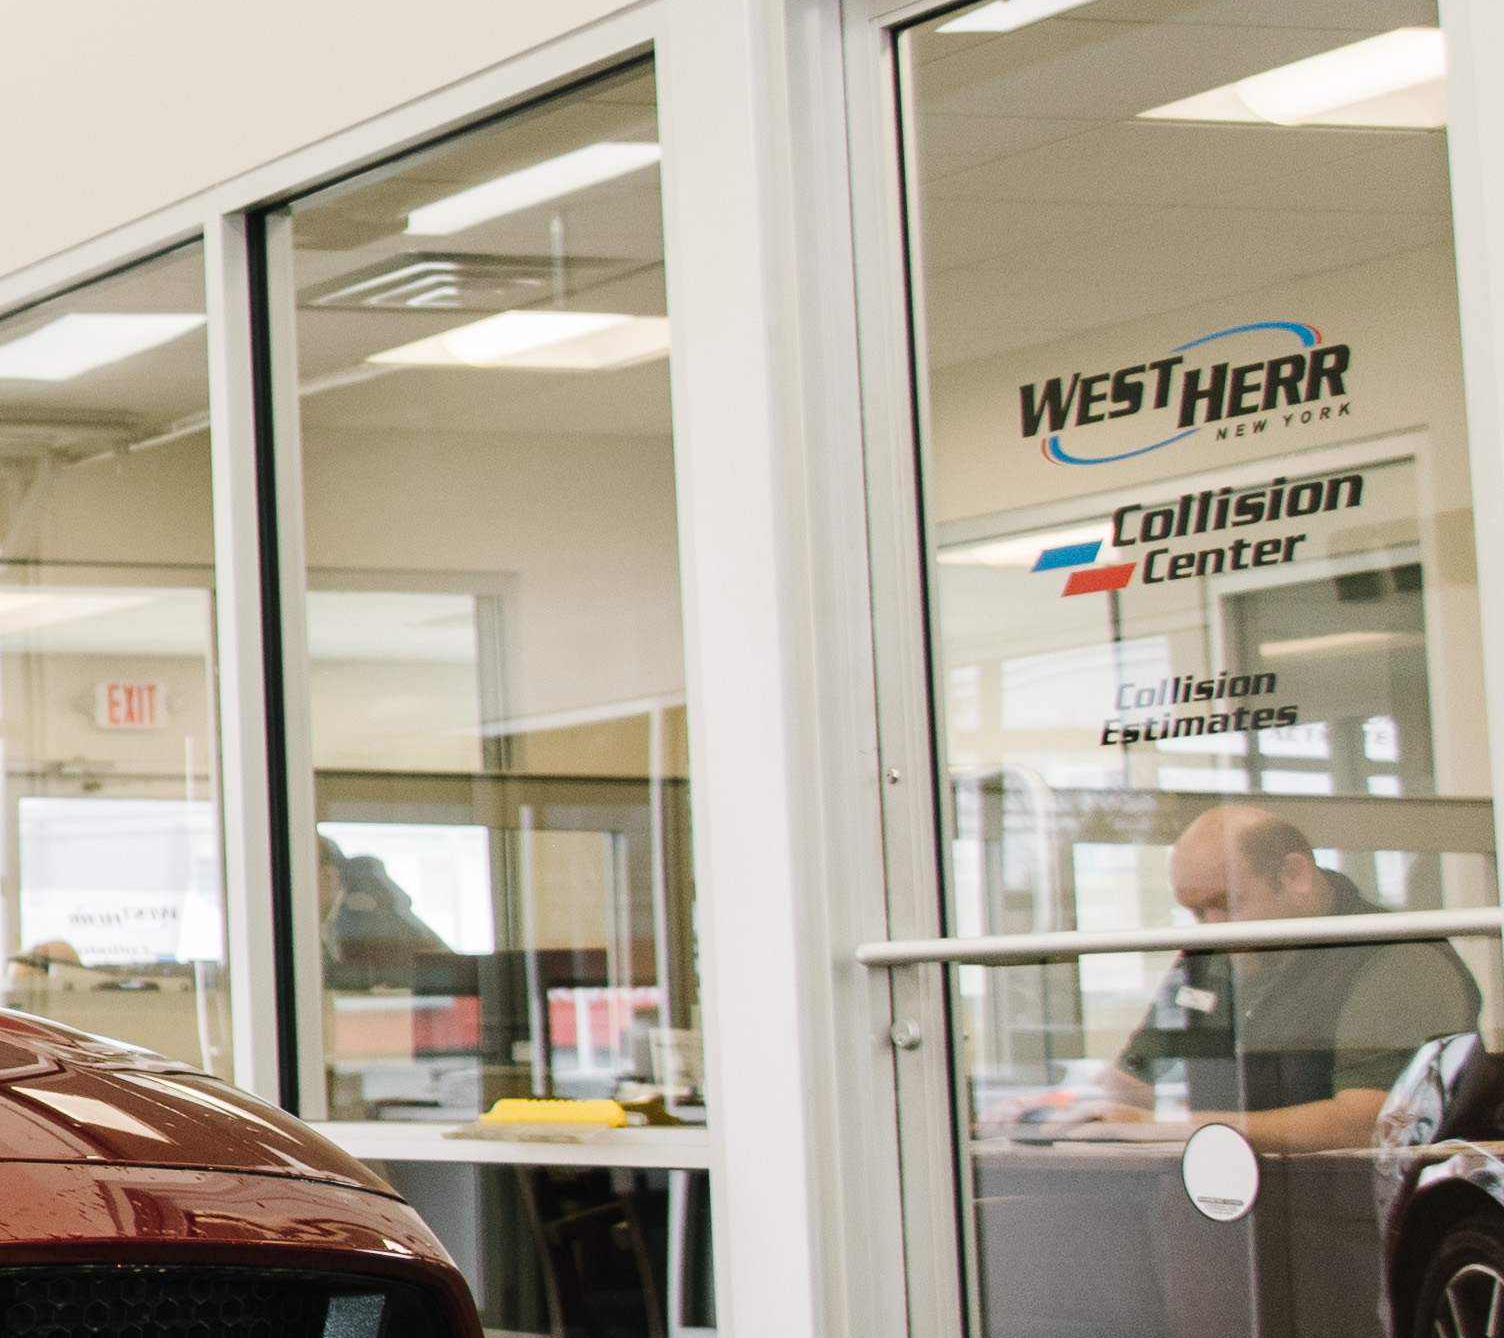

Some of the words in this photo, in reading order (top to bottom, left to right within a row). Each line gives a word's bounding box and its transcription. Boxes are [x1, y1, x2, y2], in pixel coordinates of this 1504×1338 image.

[1215, 419, 1267, 441] NEW
[1284, 402, 1350, 427] YORK
[1112, 475, 1363, 547] Collision
[1142, 534, 1306, 584] Center
[107, 683, 157, 725] EXIT
[1115, 671, 1276, 712] Collision
[1100, 705, 1297, 746] Estimates
